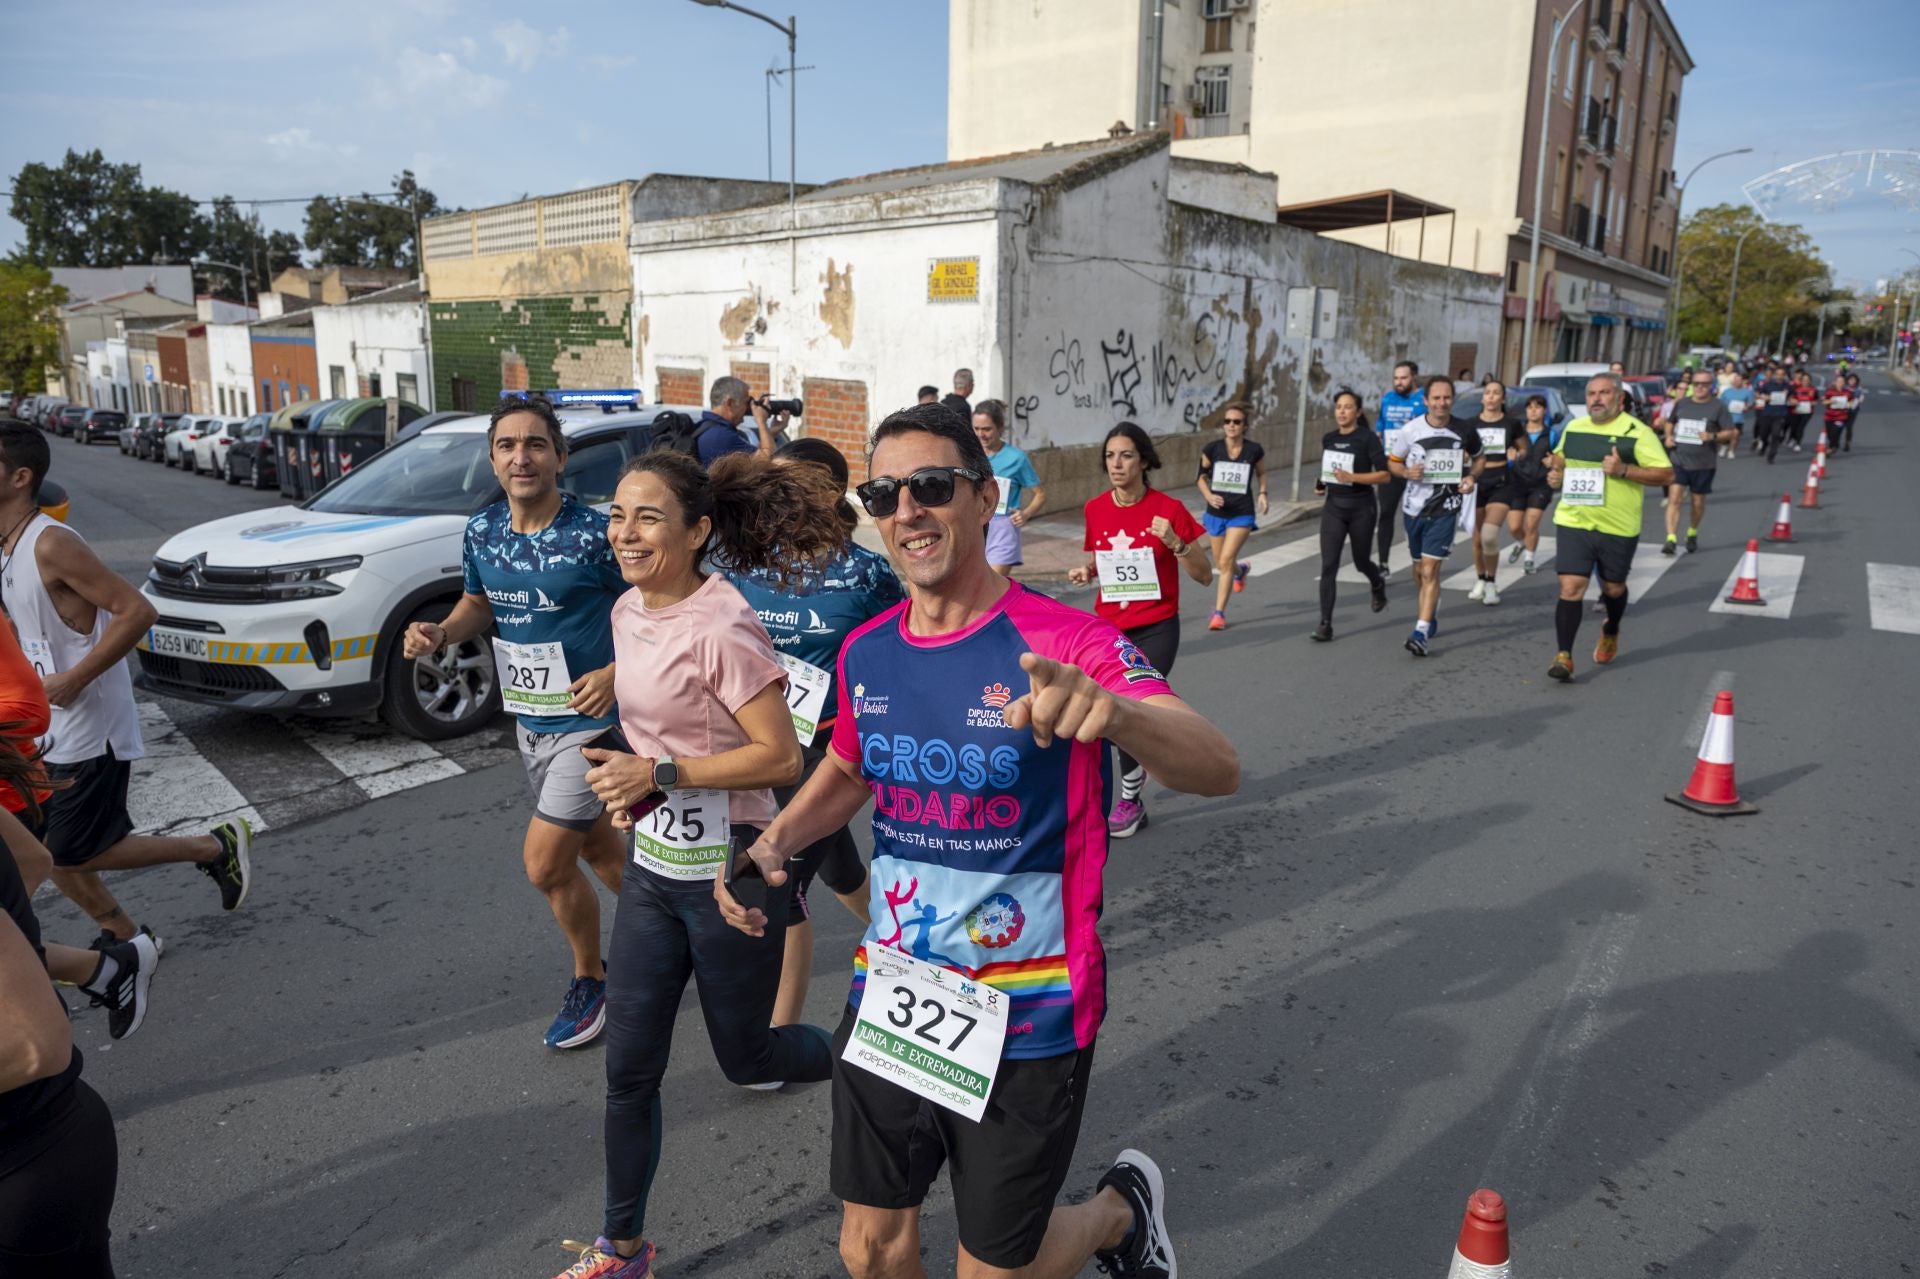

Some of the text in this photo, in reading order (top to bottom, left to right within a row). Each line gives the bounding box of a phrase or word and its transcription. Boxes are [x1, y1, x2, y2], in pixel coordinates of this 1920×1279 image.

[1430, 460, 1455, 471] 309
[1221, 471, 1242, 483] 128
[1571, 479, 1596, 493] 332
[1115, 565, 1139, 582] 53
[482, 584, 529, 604] lectrofil
[754, 609, 800, 626] ctrofil
[154, 632, 206, 657] 6259 MDC
[772, 633, 802, 648] deporte
[507, 664, 550, 690] 287
[862, 701, 888, 716] Badajoz
[968, 708, 1004, 719] DIPUTAC
[966, 718, 976, 727] DE
[898, 832, 926, 848] ESTÁ
[928, 837, 944, 851] EN
[946, 838, 972, 852] TUS
[975, 836, 1022, 852] MANOS
[652, 843, 660, 856] DE
[661, 847, 725, 862] EXTREMADURA
[887, 985, 978, 1053] 327
[857, 1023, 984, 1094] JUNTA DE EXTREMADURA
[857, 1048, 971, 1107] #deporteresponsable
